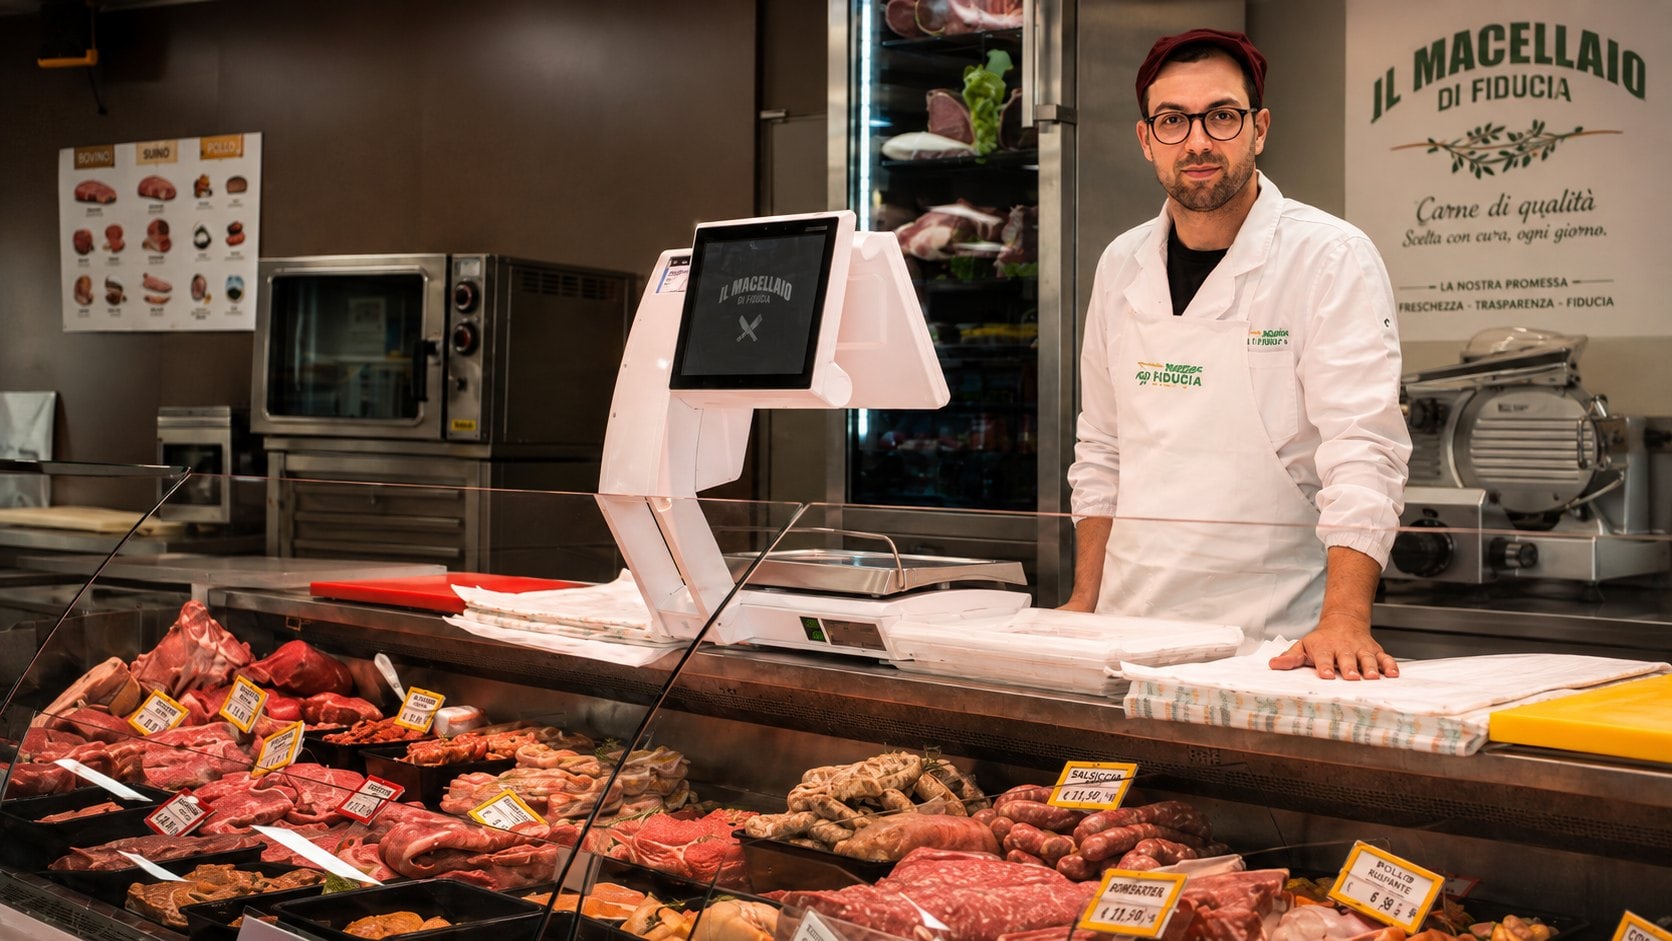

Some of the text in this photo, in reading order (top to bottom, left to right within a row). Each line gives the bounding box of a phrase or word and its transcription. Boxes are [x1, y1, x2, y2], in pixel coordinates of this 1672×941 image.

[1370, 21, 1647, 125] IL MACELLAIO
[1438, 74, 1572, 112] DI FIDUCIA
[78, 152, 110, 164] BOVINO
[143, 146, 170, 160] SUINO
[1415, 188, 1596, 226] Carne di qualità
[1402, 222, 1608, 248] Scelta con cura, ogni giorno.
[718, 275, 793, 304] IL MACELLAIO
[1440, 277, 1569, 292] LA NOSTRA PROMESSA
[1398, 301, 1464, 313] FRESCHEZZA
[1475, 298, 1554, 311] TRASPARENZA
[1566, 296, 1615, 308] FIDUCIA
